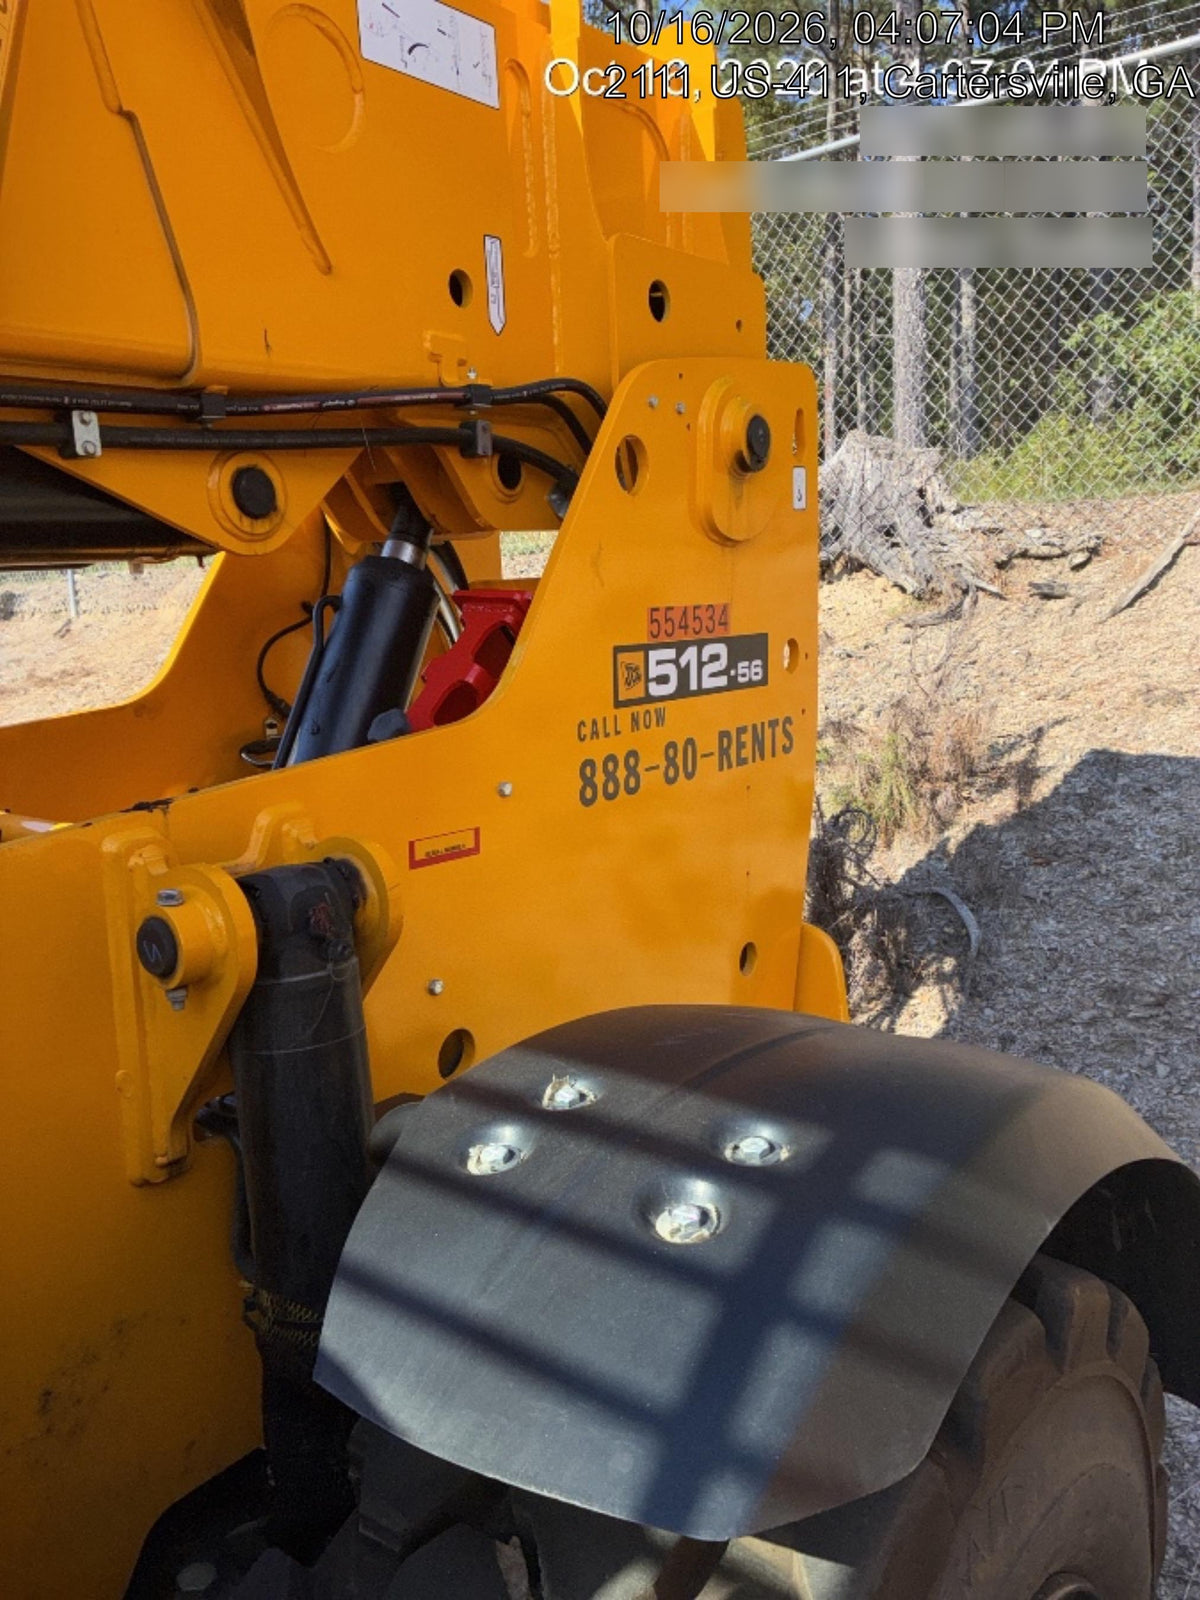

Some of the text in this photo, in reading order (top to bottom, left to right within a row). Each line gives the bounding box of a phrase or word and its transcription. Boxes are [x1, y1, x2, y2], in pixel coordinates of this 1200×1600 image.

[649, 604, 729, 638] 554534
[577, 707, 666, 742] CALL NOW
[579, 716, 794, 807] 888-80-RENTS
